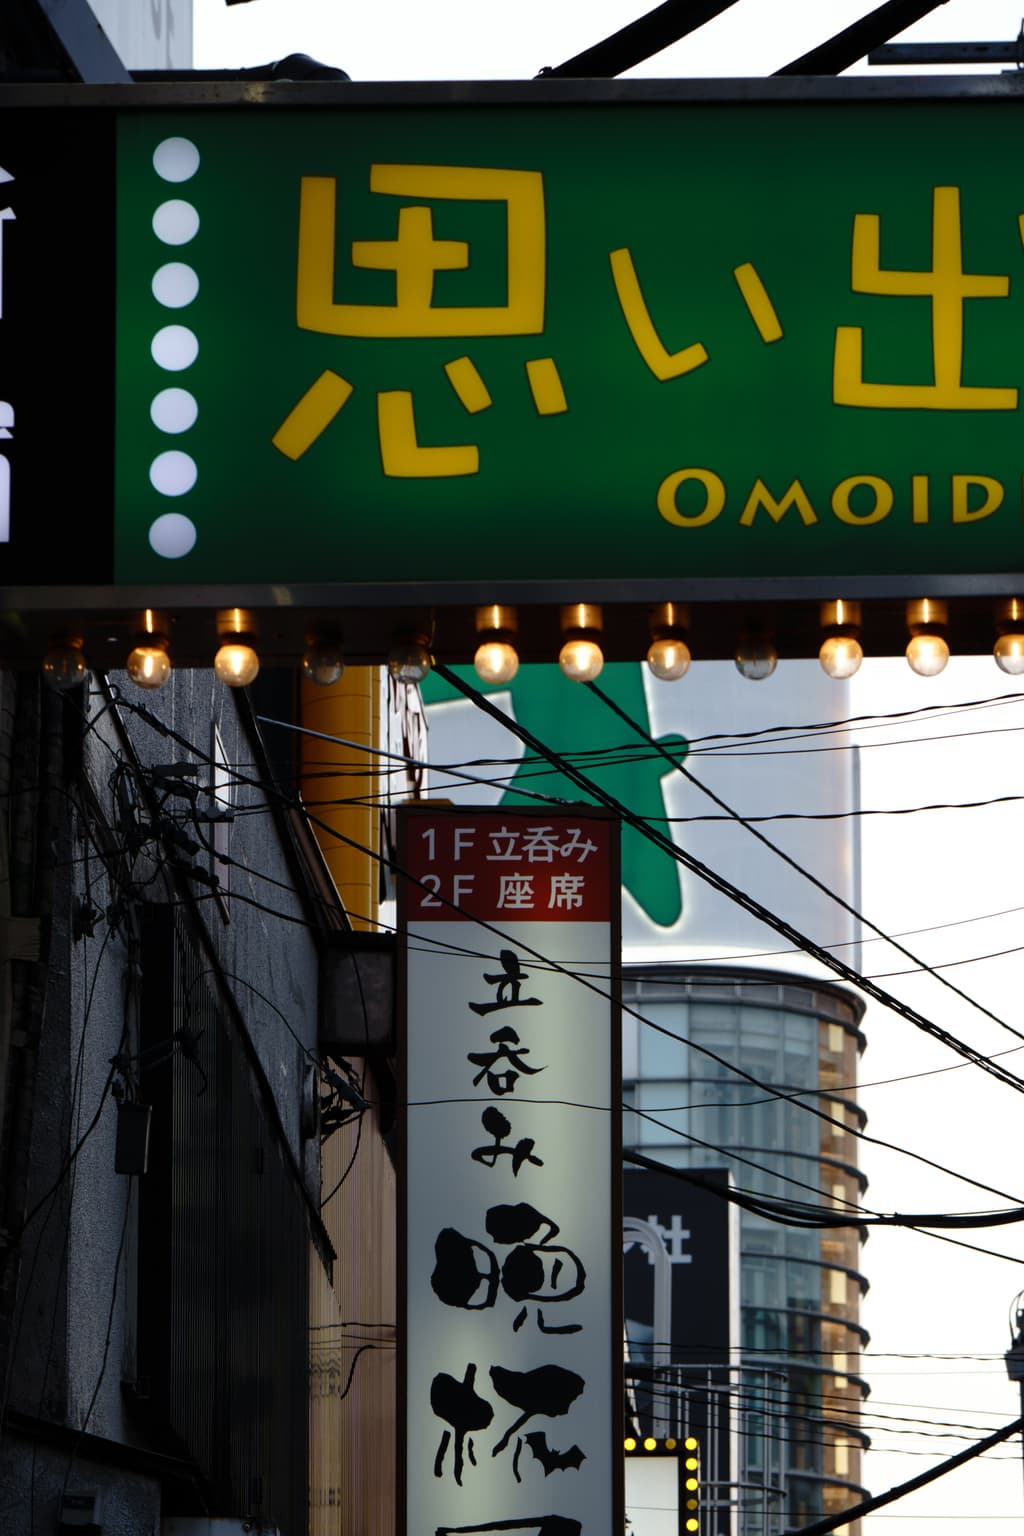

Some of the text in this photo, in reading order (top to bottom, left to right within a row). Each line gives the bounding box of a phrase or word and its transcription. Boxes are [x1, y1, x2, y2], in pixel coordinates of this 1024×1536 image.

[421, 826, 599, 863] 1F 立呑み
[420, 872, 586, 910] 2F 座席
[467, 949, 548, 1178] 立呑み
